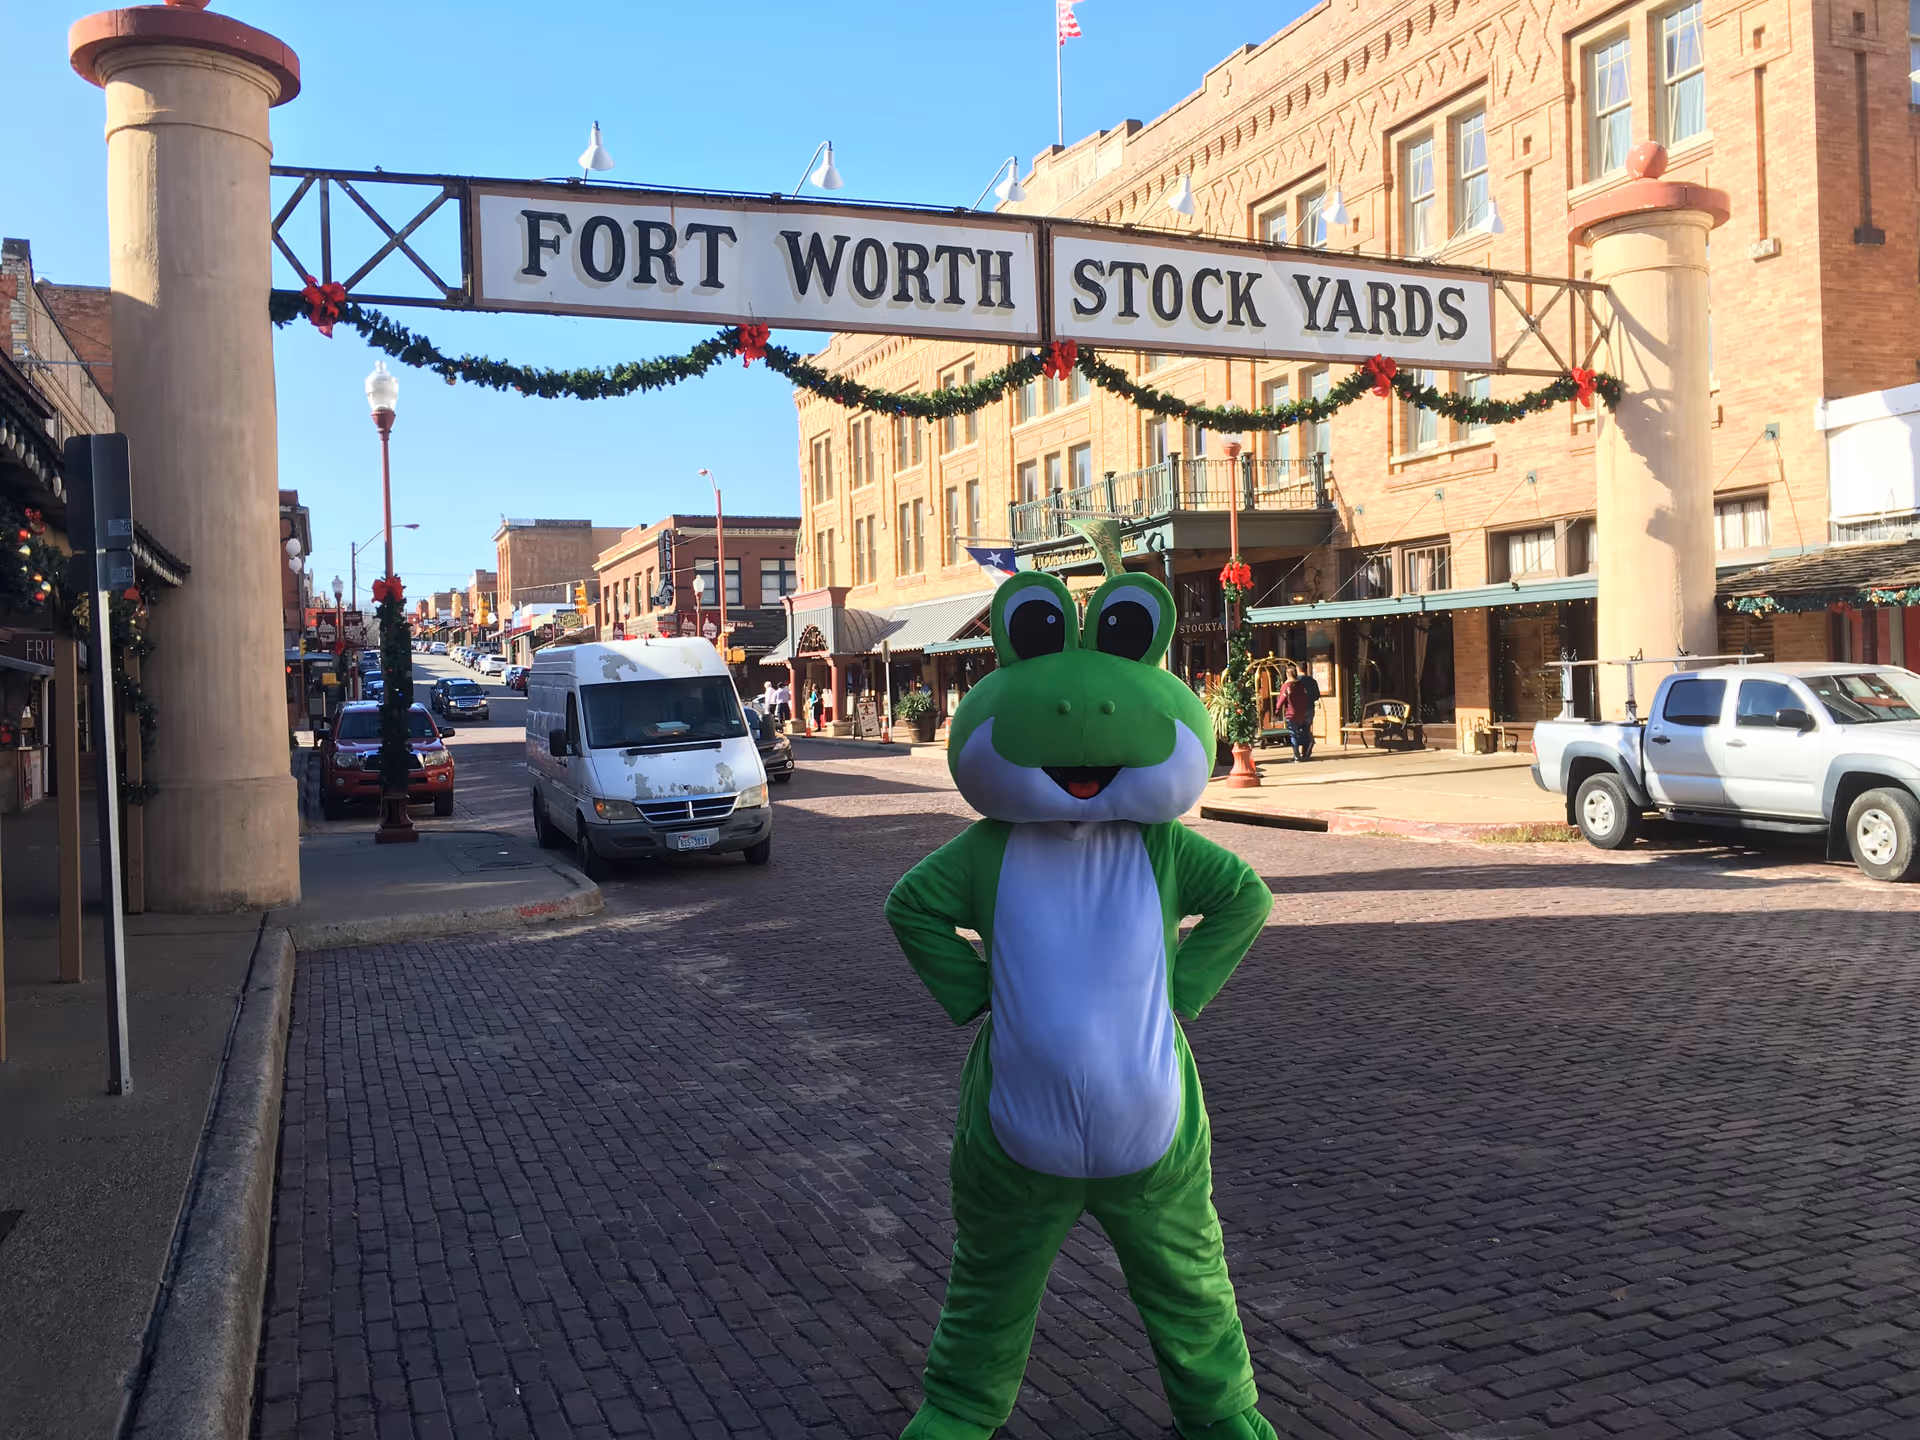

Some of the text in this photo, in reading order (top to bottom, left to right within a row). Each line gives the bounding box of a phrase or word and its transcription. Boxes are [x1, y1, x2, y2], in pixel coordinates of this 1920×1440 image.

[520, 209, 1468, 341] FORT WORTH STOCK YARDS
[1180, 622, 1226, 634] STOCKYA
